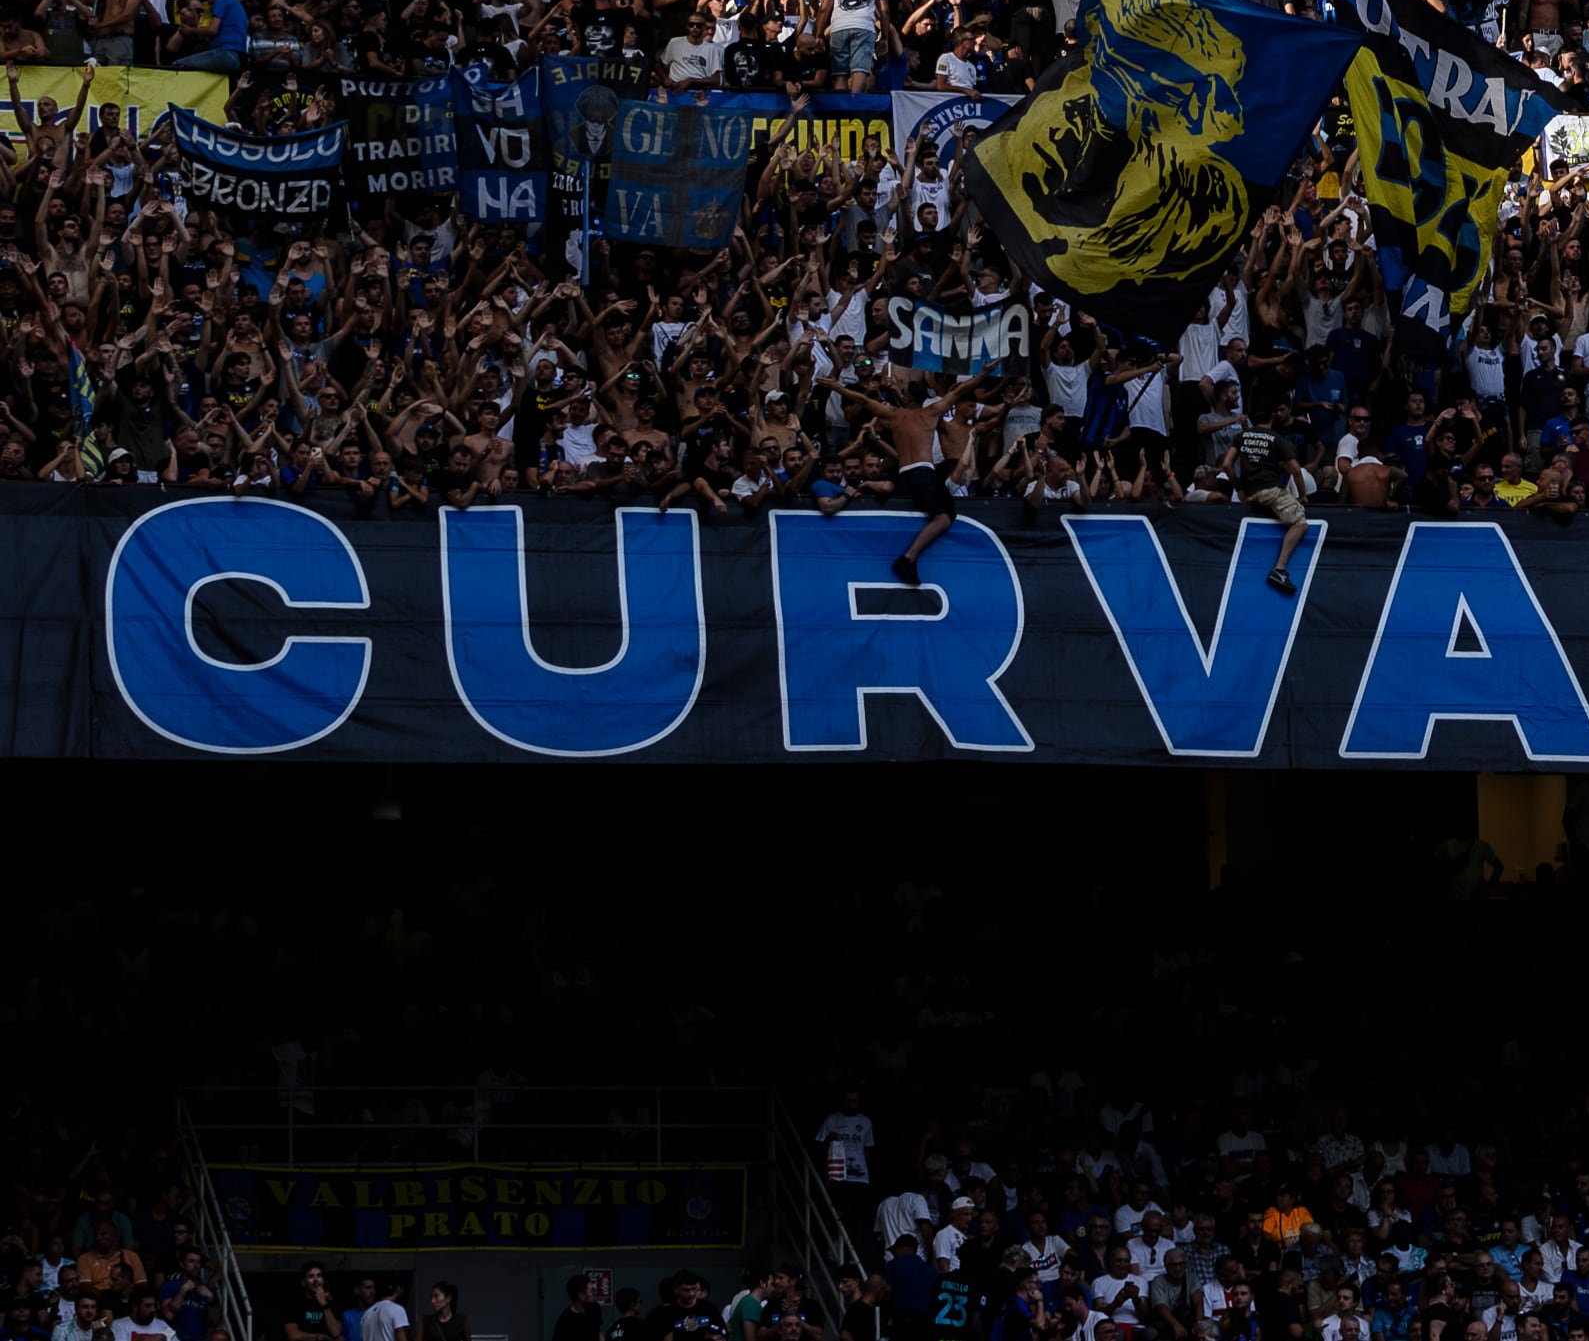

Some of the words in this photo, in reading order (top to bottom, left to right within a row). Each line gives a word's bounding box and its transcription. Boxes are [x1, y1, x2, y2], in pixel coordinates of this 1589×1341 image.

[887, 295, 1031, 361] SANNA
[263, 1172, 672, 1208] VALBISENZIO
[388, 1211, 553, 1239] PRATO
[934, 1291, 970, 1329] 23
